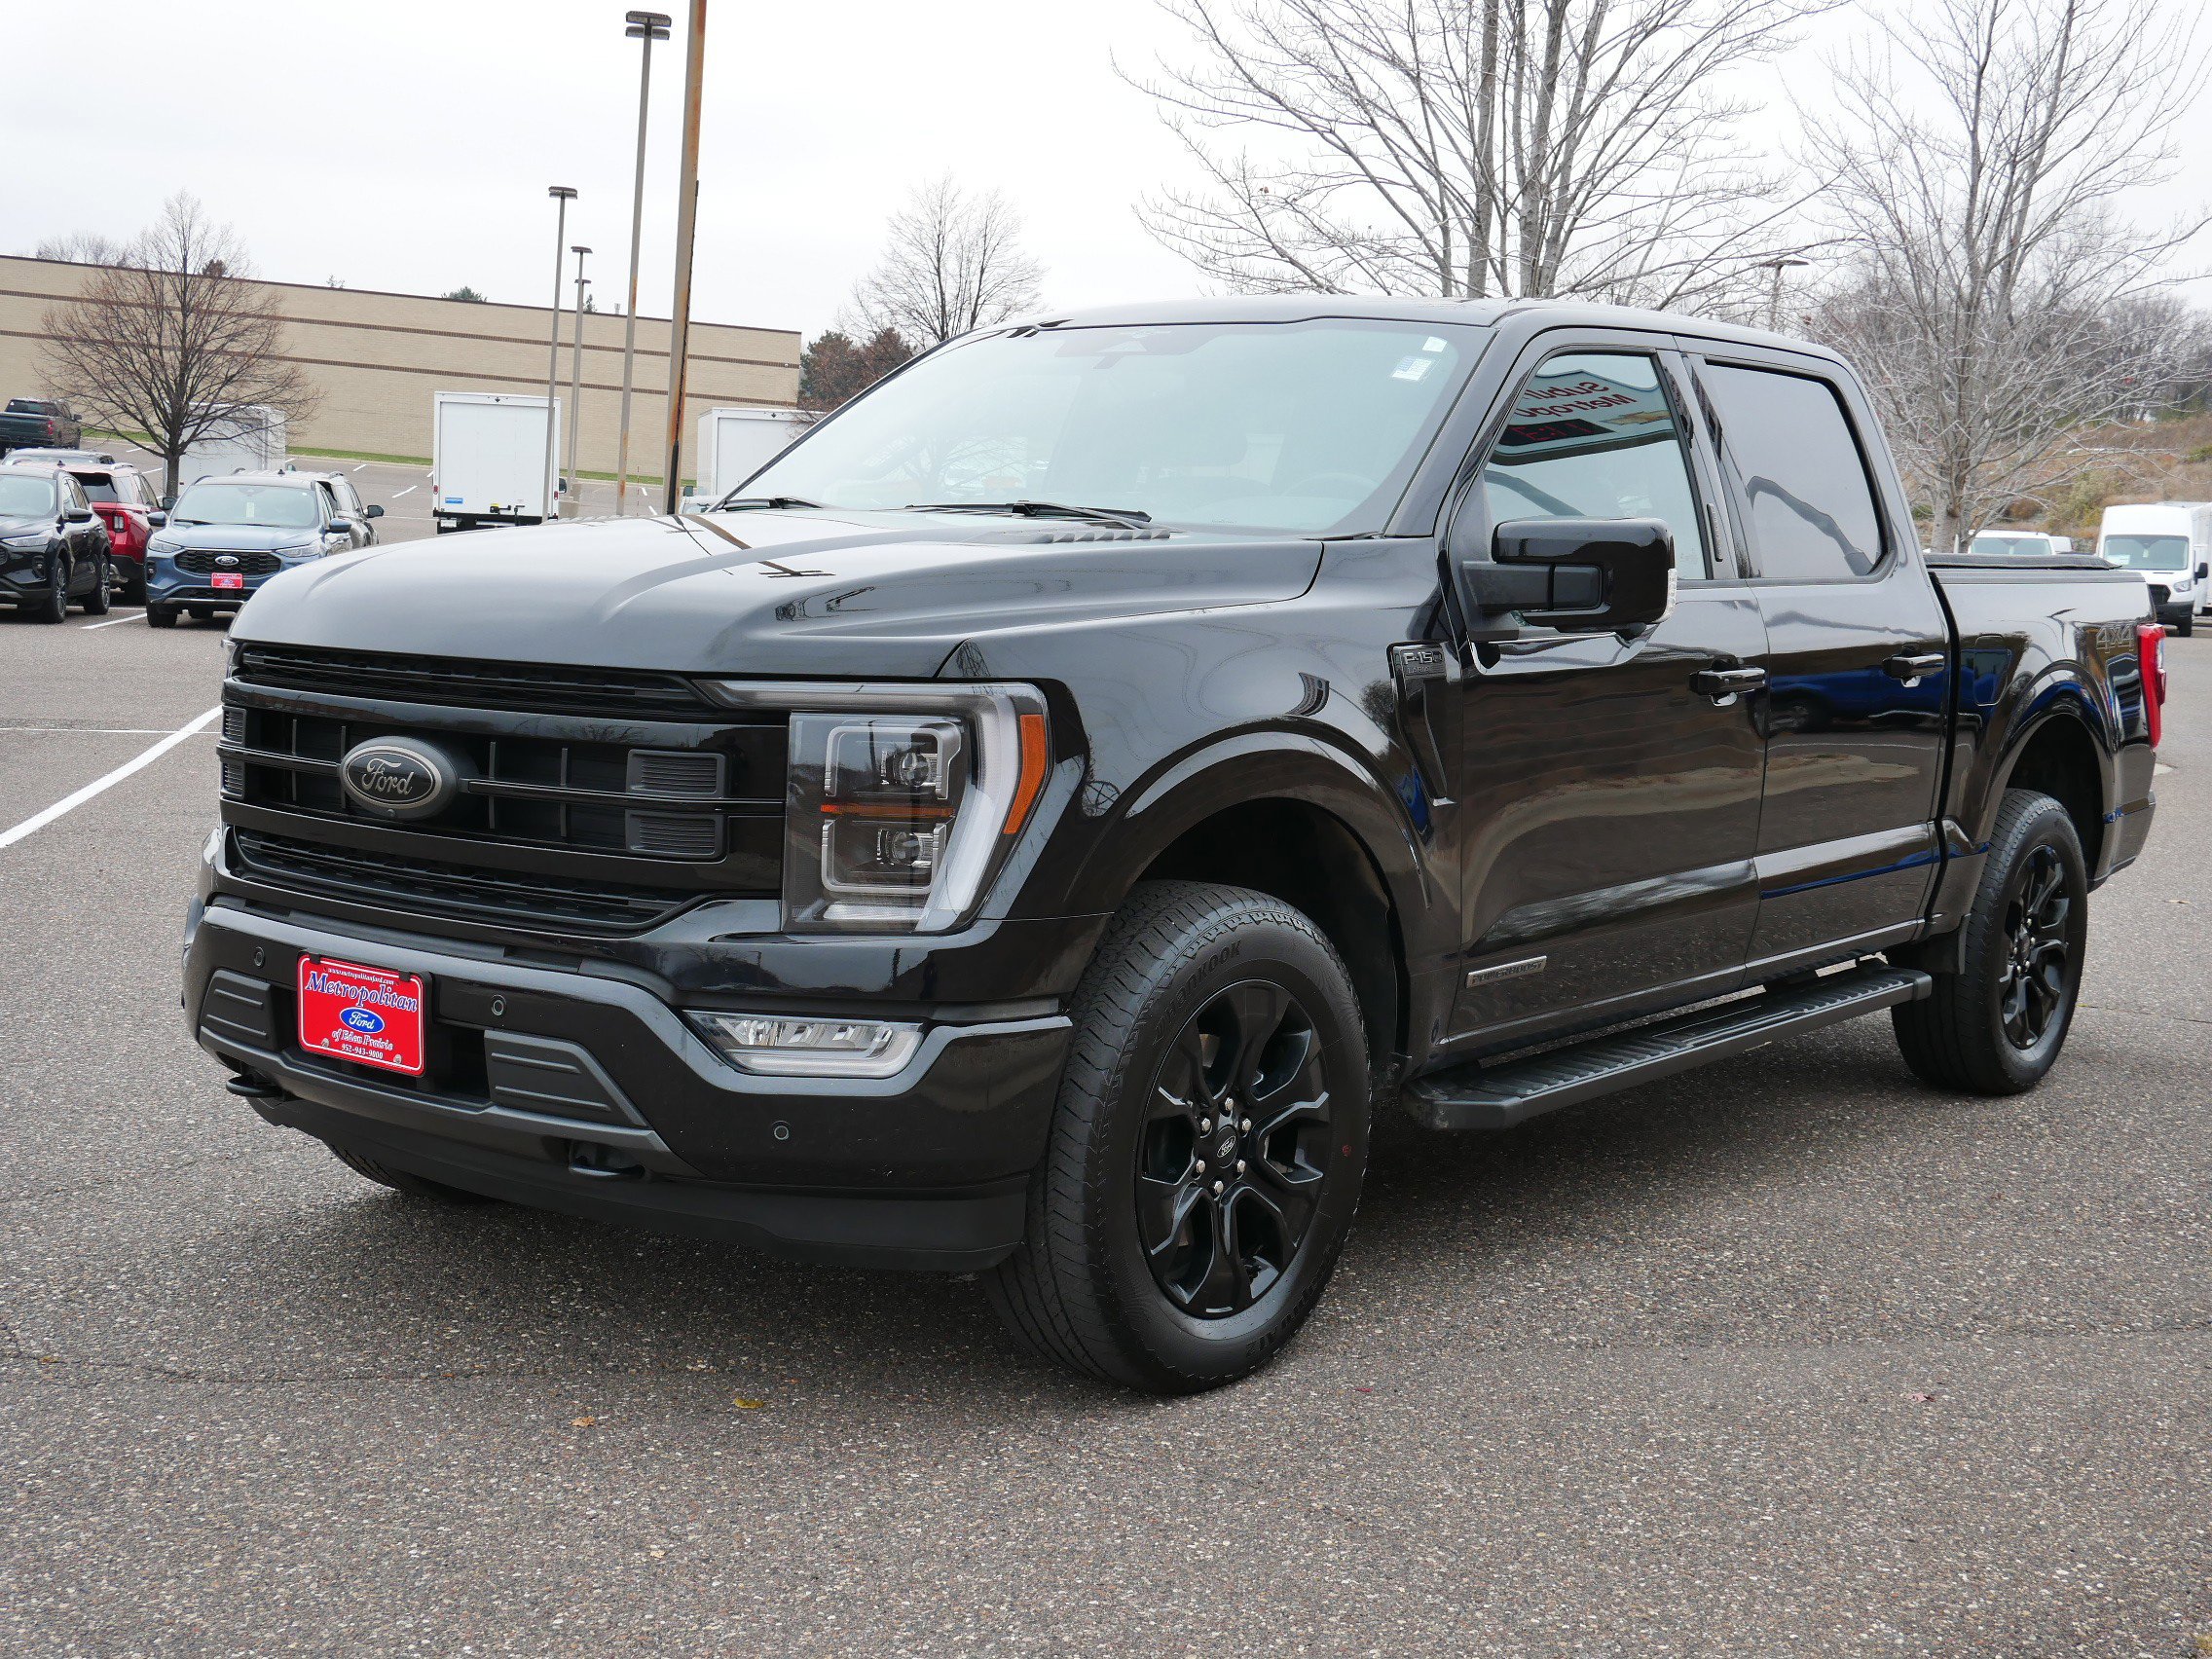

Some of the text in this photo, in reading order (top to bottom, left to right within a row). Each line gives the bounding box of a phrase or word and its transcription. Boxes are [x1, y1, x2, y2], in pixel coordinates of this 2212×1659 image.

[1403, 650, 1443, 666] F-150
[361, 757, 415, 795] Ford
[305, 971, 418, 1013] Metropolitan
[349, 1011, 375, 1030] Ford
[332, 1028, 393, 1051] of Eden Prairie
